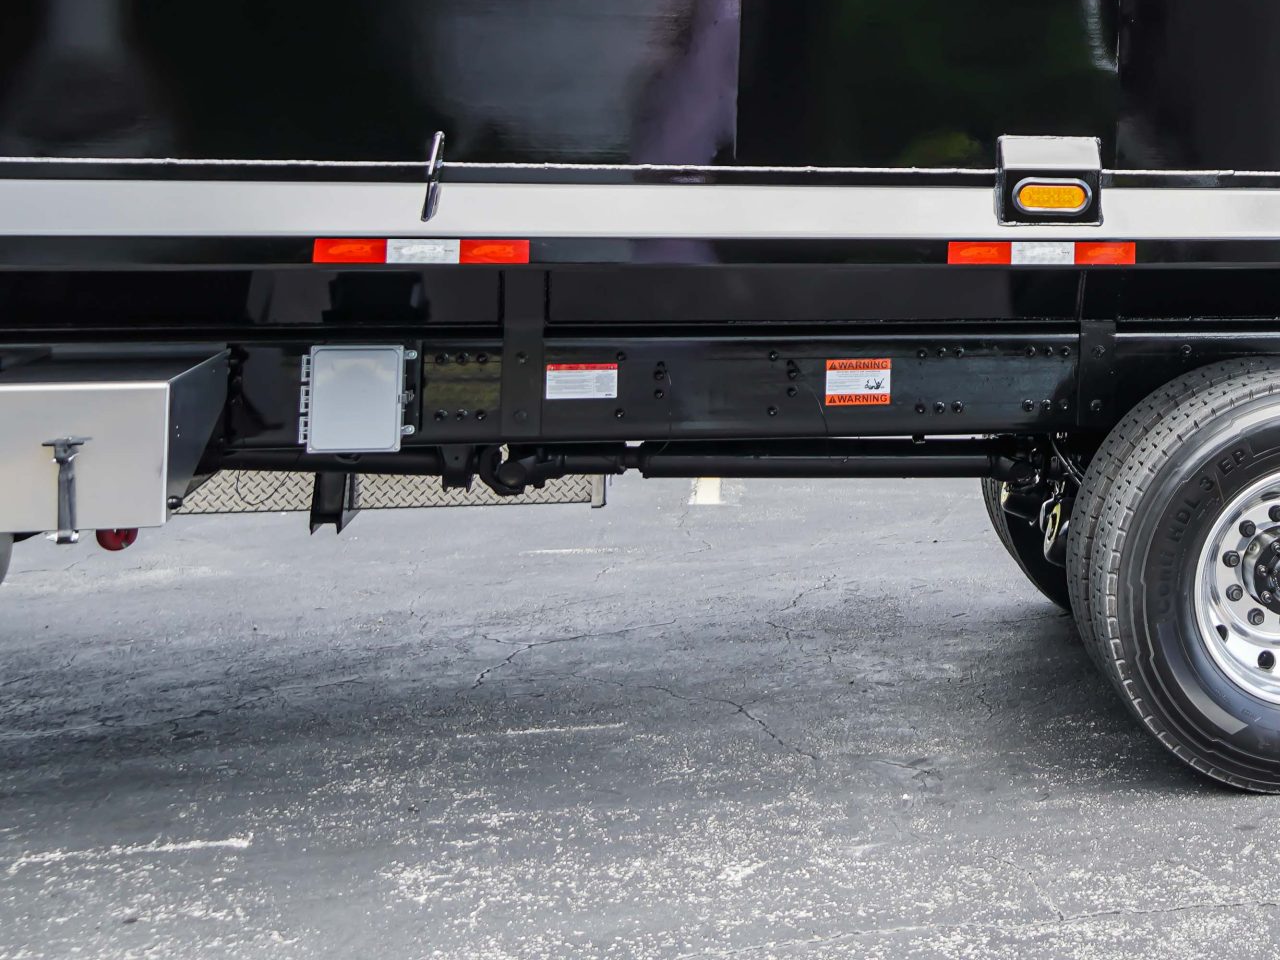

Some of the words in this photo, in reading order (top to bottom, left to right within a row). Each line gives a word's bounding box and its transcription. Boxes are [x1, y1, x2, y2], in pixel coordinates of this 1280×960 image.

[838, 360, 888, 370] WARNING
[837, 393, 888, 403] WARNING
[1217, 448, 1246, 476] EP
